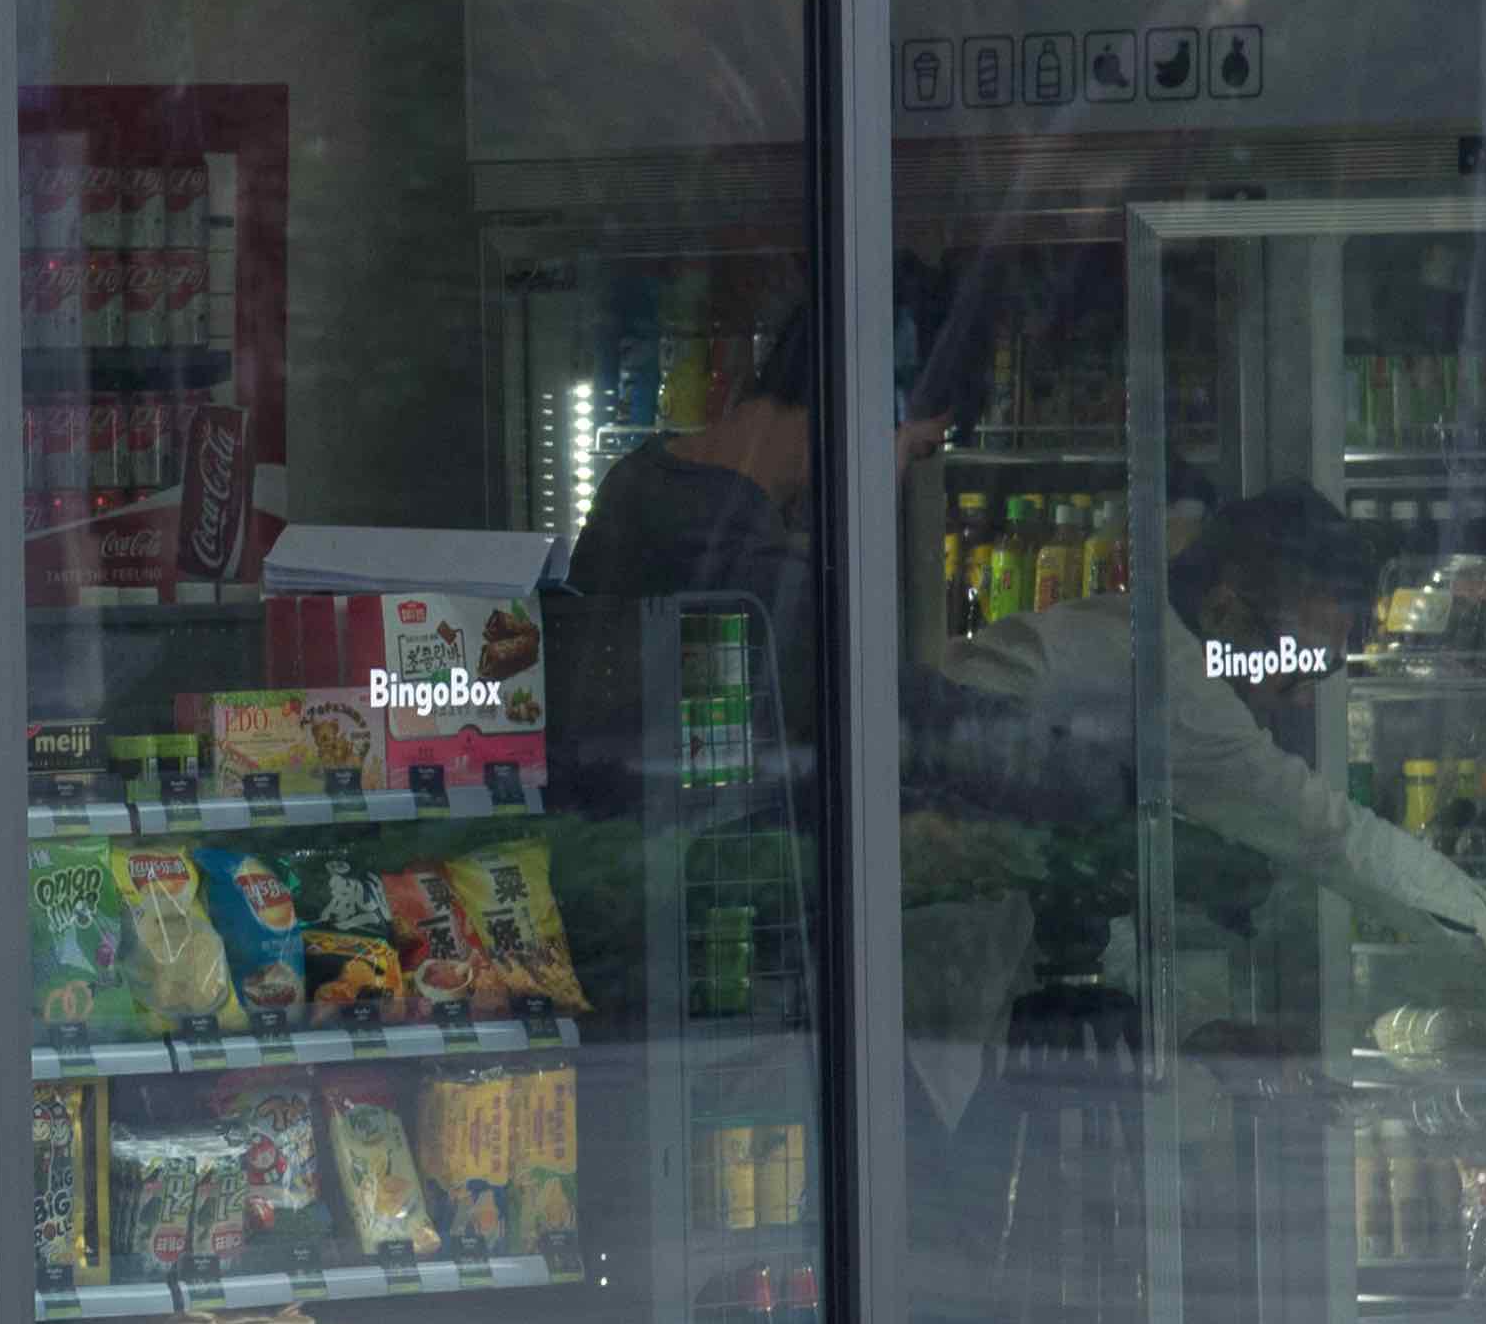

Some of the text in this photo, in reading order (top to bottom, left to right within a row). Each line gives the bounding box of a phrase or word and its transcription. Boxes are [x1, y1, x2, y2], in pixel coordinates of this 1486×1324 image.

[1206, 635, 1328, 684] BingoBox
[370, 667, 502, 717] BingoBox
[35, 726, 91, 757] meiji
